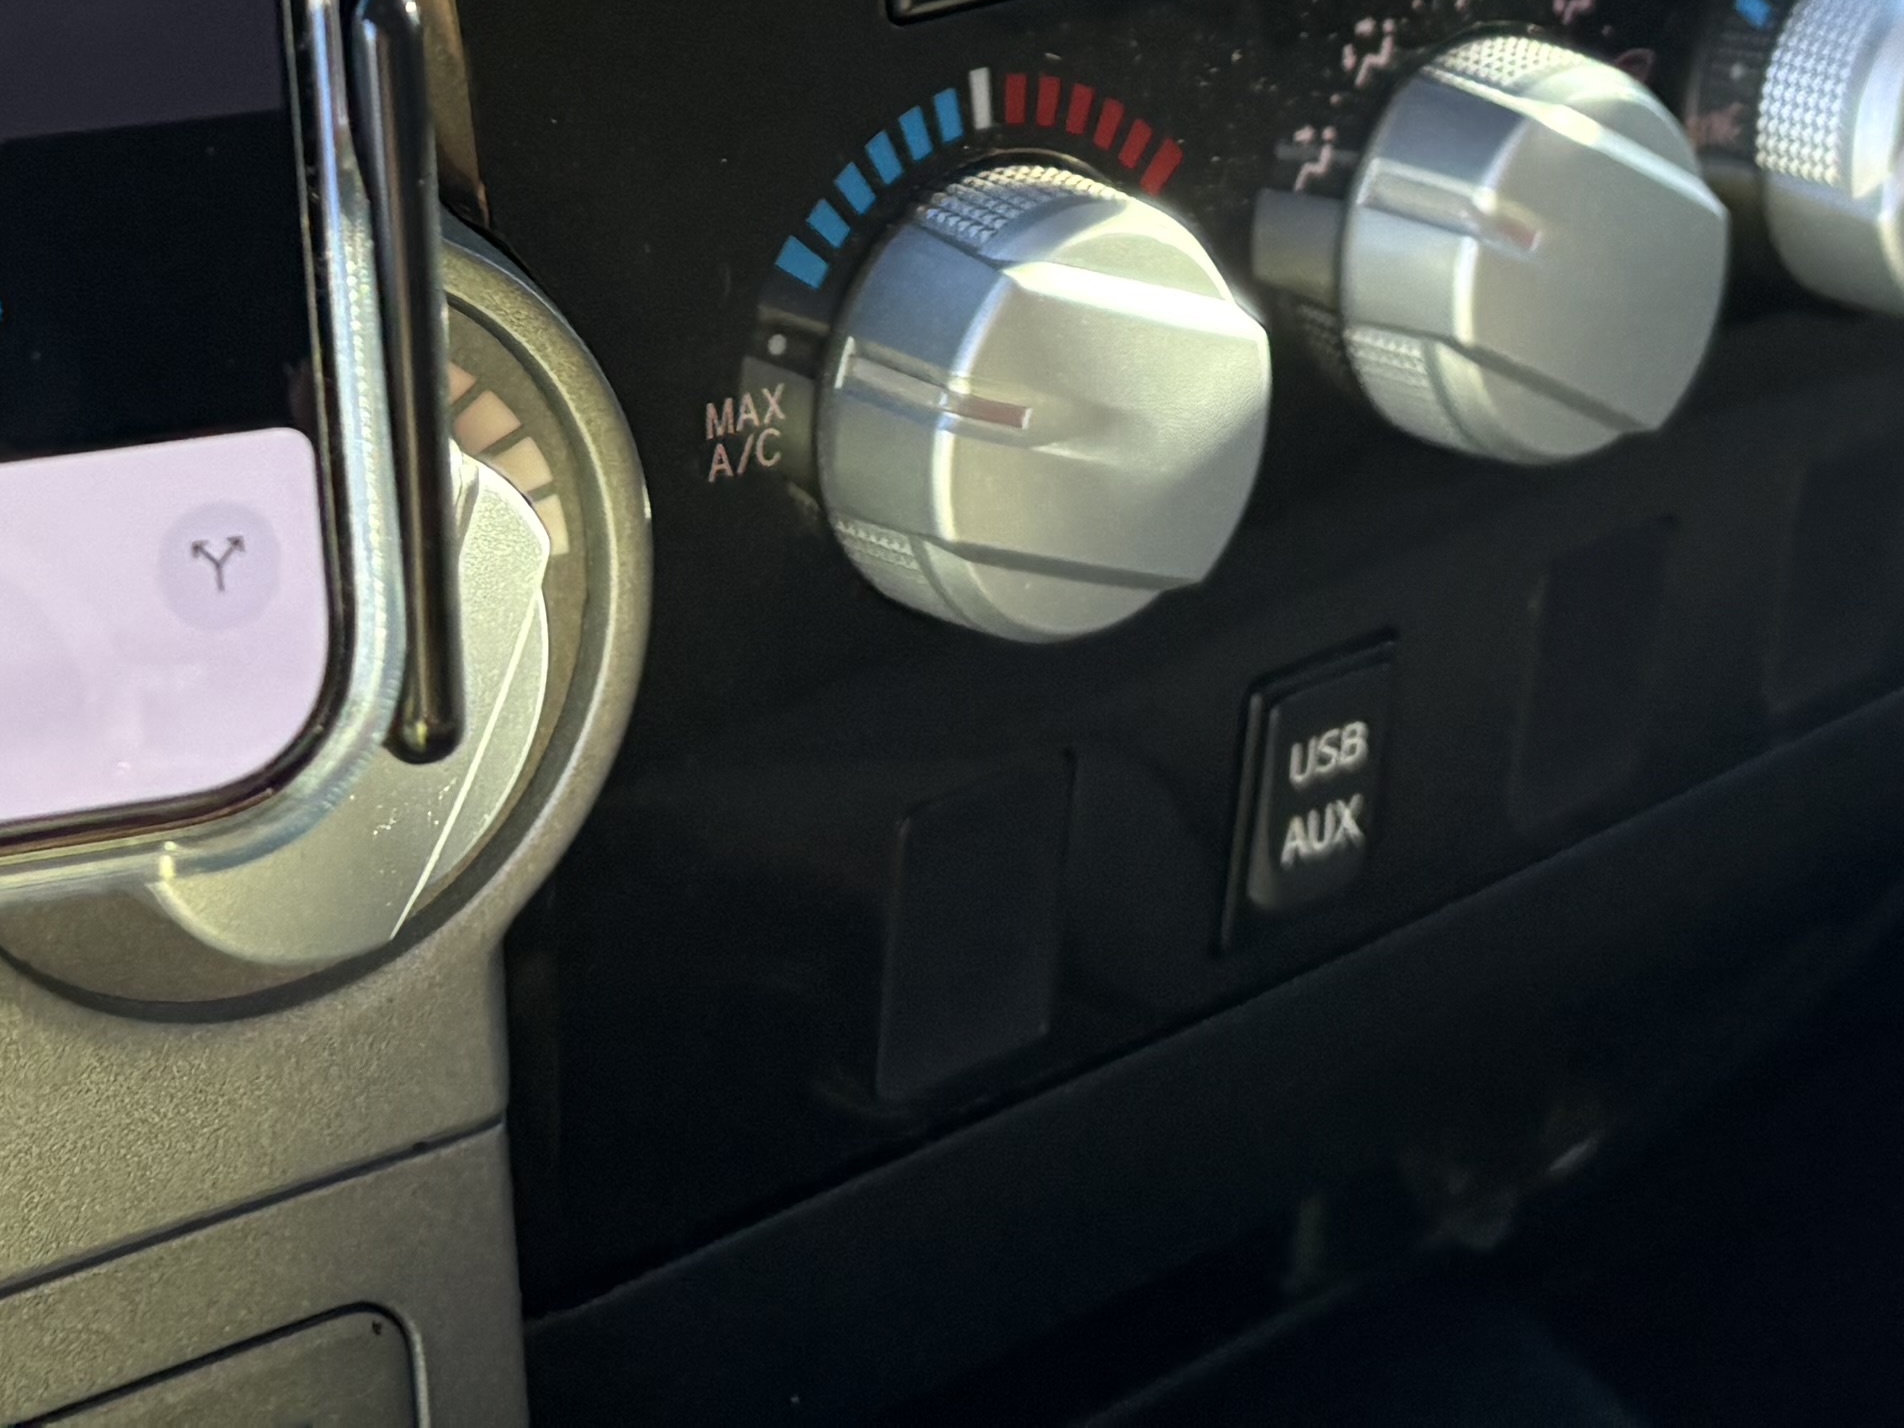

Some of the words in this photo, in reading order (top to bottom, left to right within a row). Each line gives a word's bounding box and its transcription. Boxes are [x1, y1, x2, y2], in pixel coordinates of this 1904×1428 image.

[704, 382, 786, 441] MAX
[707, 427, 782, 484] A/C
[1289, 720, 1368, 787] USB
[1280, 793, 1365, 868] AUX
